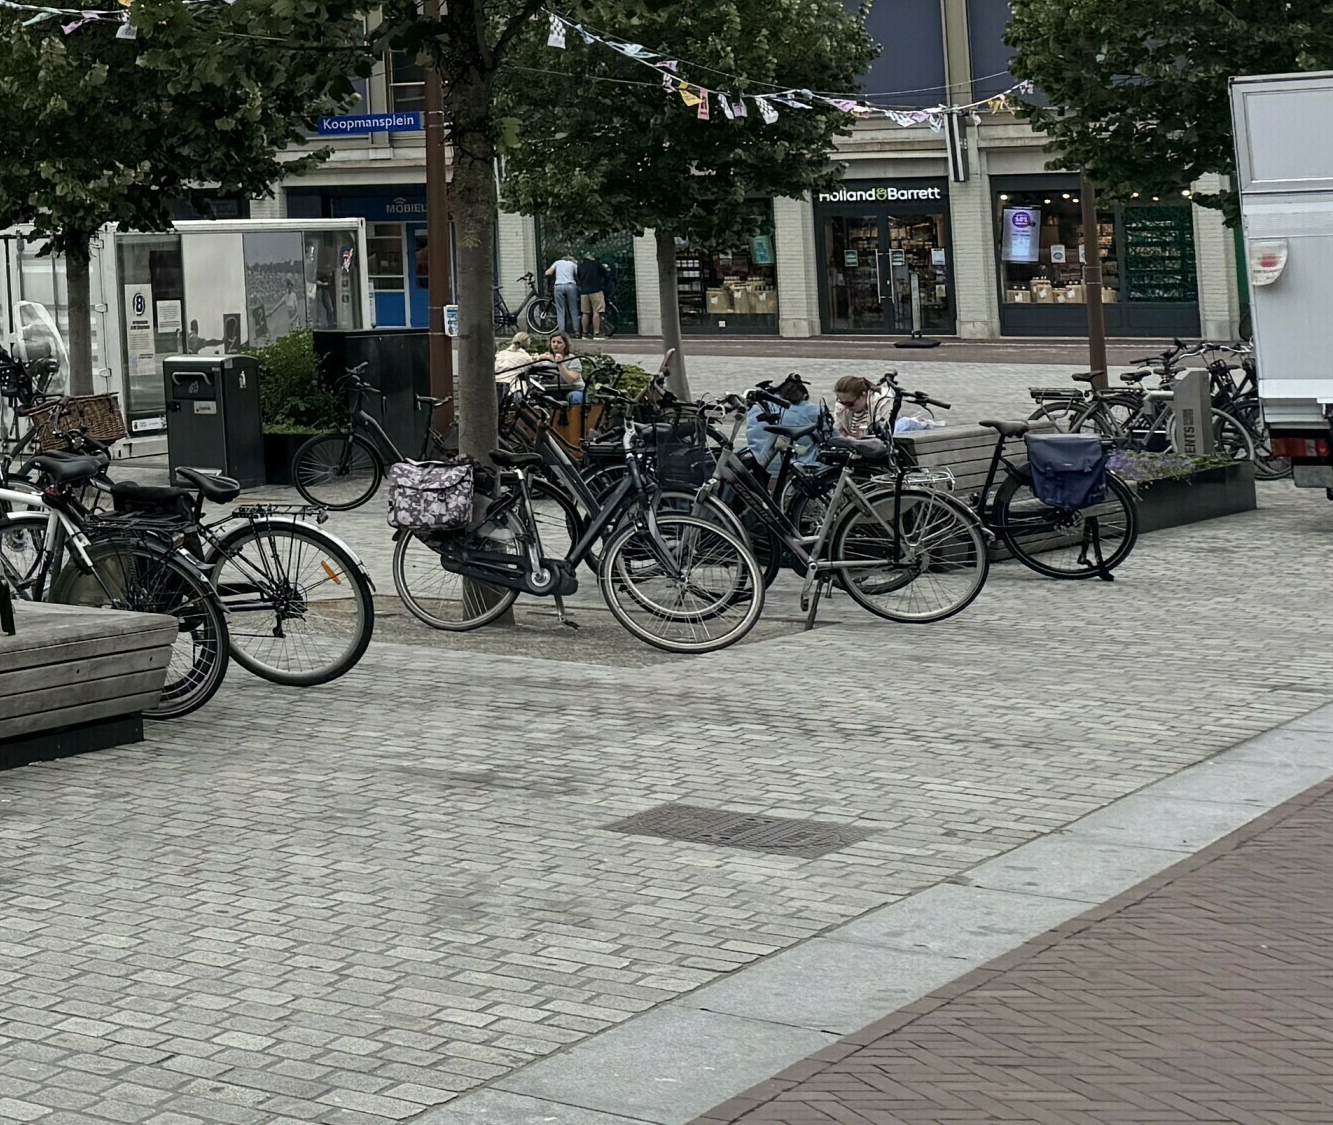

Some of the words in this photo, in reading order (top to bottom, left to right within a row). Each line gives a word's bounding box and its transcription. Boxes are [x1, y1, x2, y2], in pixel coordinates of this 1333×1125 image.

[322, 114, 415, 131] Koopmansplein
[887, 186, 941, 200] Barrett
[1183, 426, 1196, 455] ENTS
